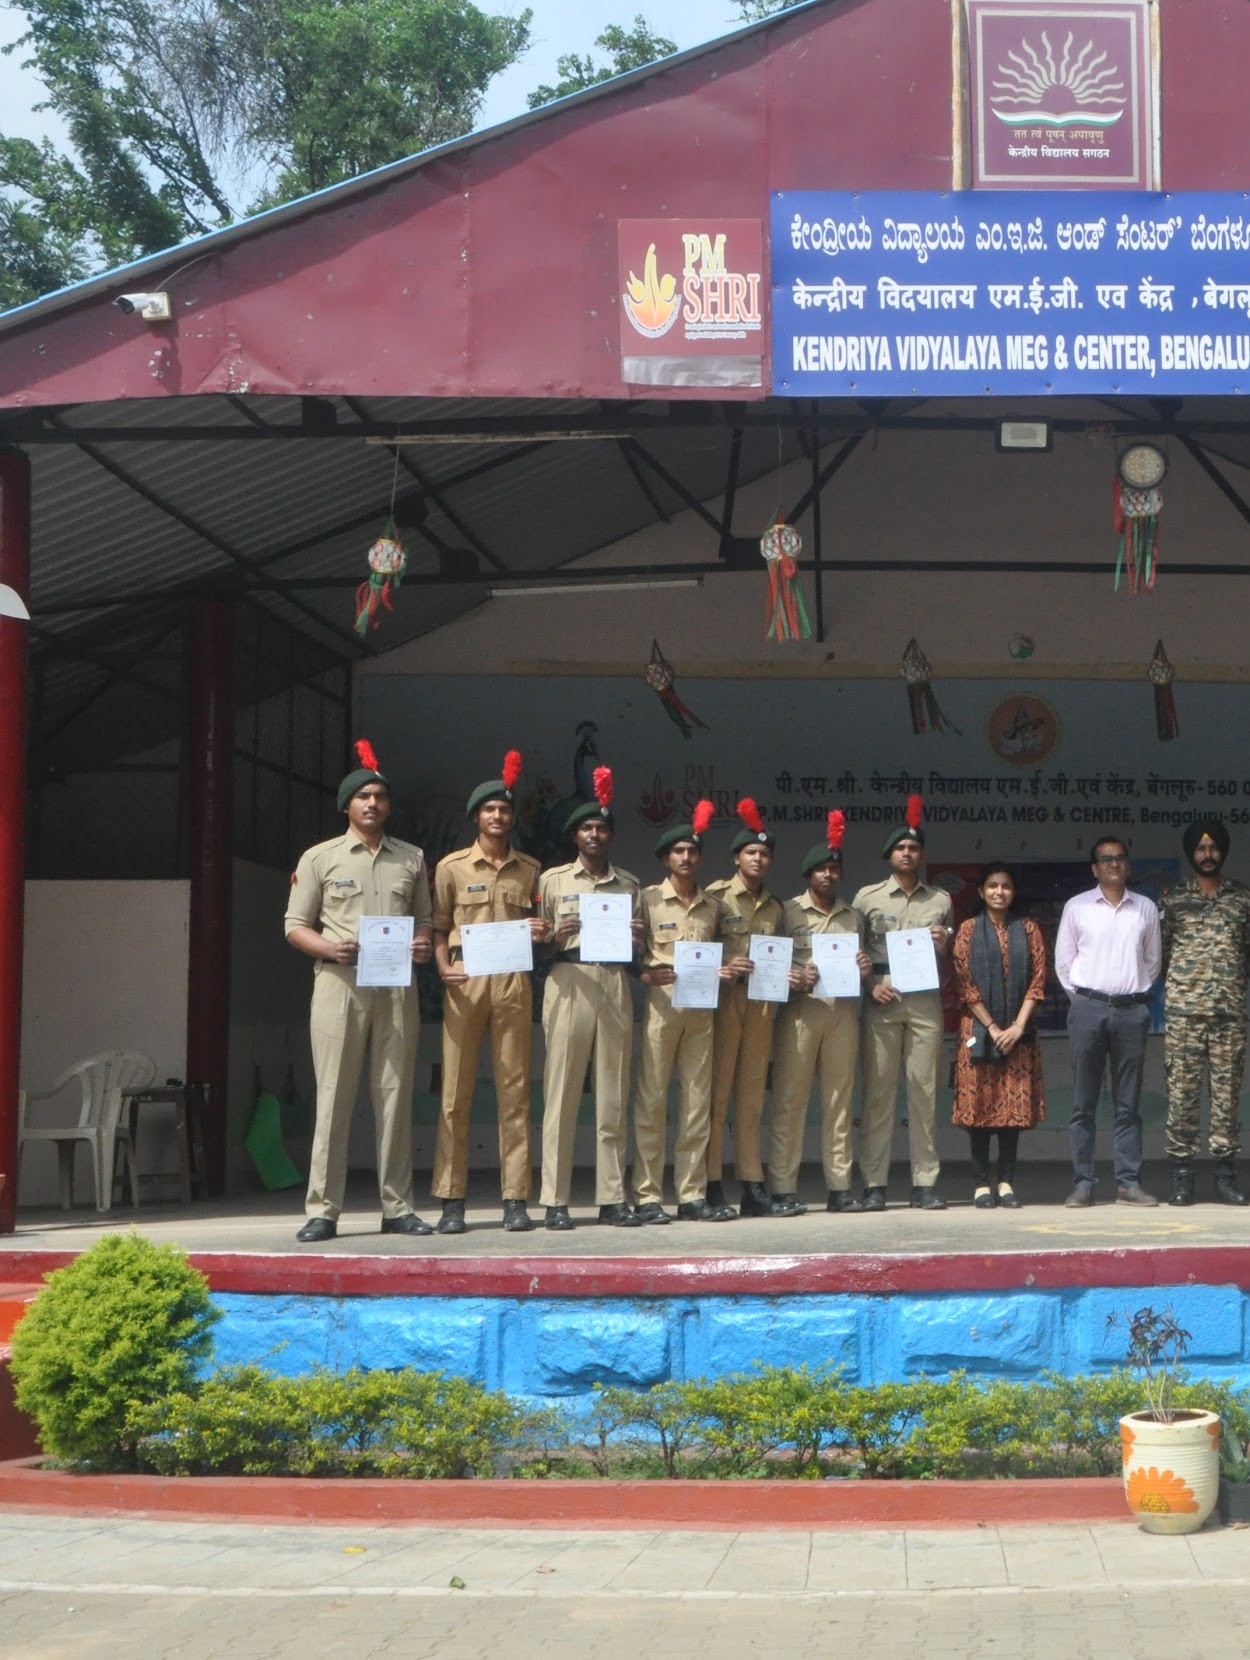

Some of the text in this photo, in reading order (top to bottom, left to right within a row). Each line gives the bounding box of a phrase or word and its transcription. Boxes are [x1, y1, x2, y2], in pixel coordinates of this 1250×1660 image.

[682, 234, 727, 276] PM
[683, 273, 761, 322] SHRI
[793, 336, 892, 371] KENDRIYA
[896, 335, 1002, 370] VIDYALAYA
[1006, 335, 1048, 370] MEG
[1054, 335, 1069, 370] &
[1074, 335, 1155, 378] CENTER,
[839, 806, 908, 823] KENDRIY
[924, 806, 1008, 823] VIDYALAYA
[1012, 806, 1049, 822] MEG
[1053, 806, 1066, 823] &
